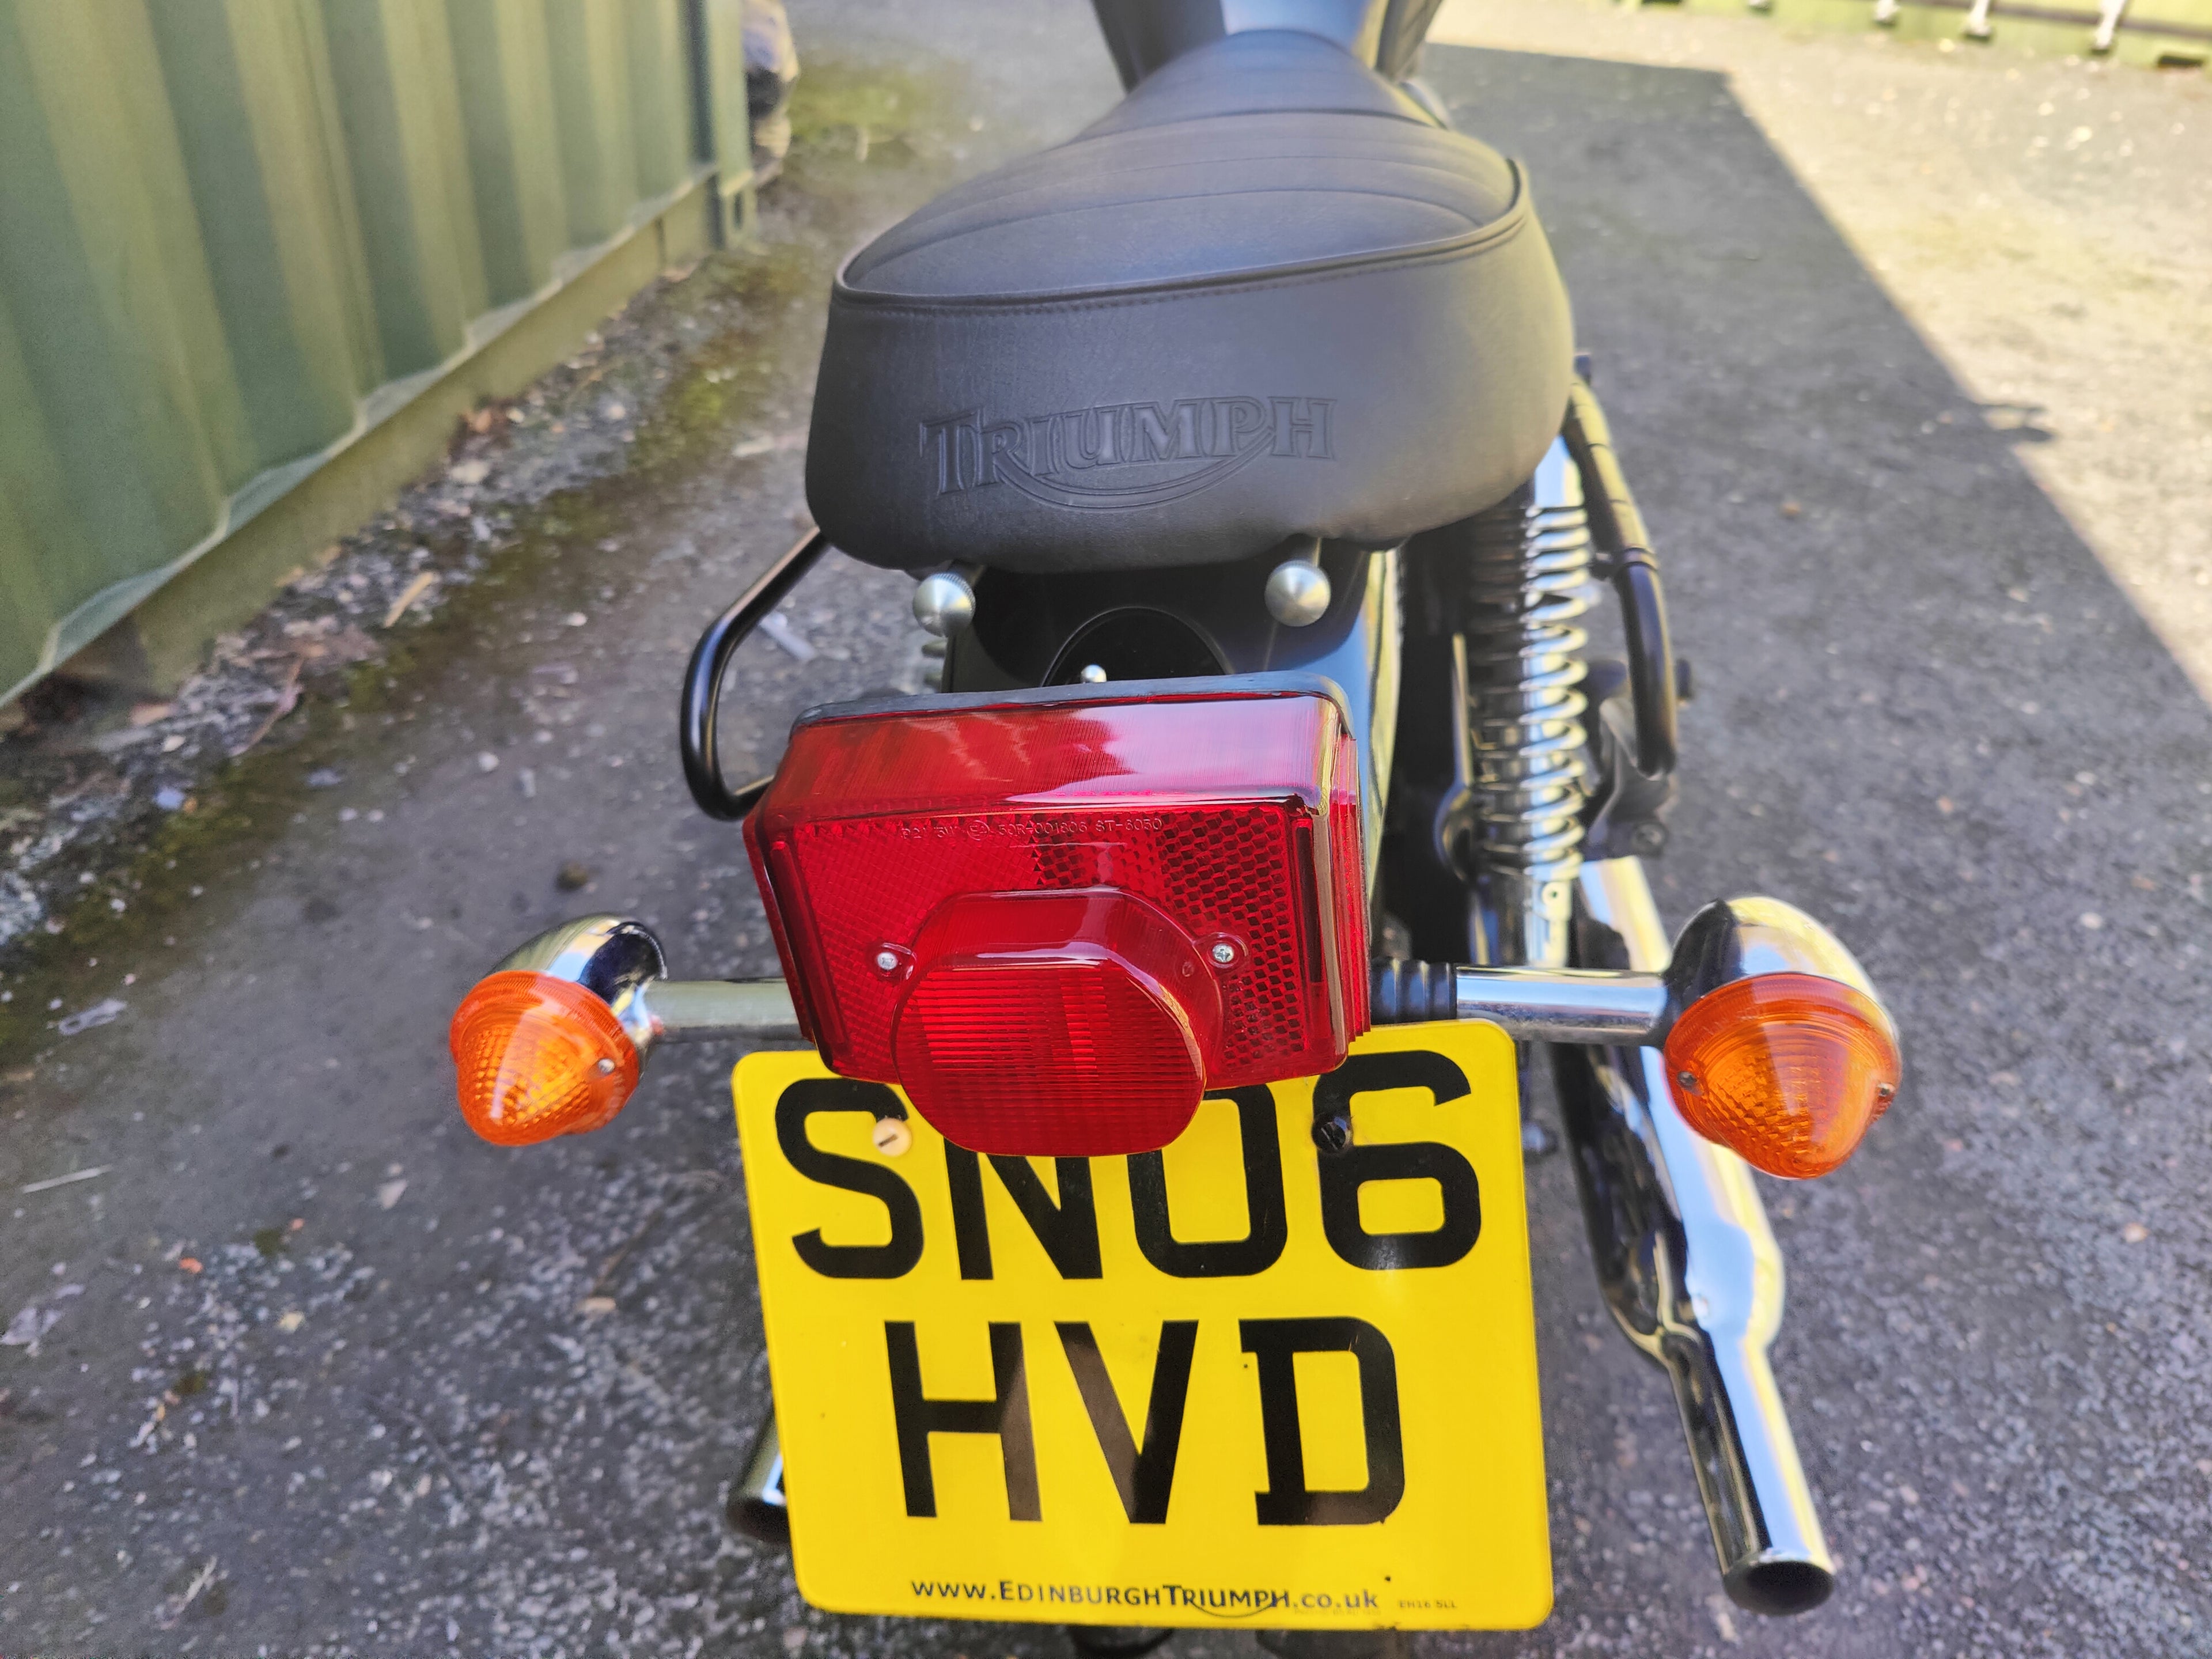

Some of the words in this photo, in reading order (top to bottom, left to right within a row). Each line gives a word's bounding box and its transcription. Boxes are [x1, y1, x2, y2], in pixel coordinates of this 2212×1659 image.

[919, 395, 1338, 512] TRIUMPH
[775, 1050, 1482, 1280] SN06
[884, 1316, 1406, 1526] HVD
[911, 1580, 1378, 1617] www.EDINBURGHTRIUMPH.co.uk
